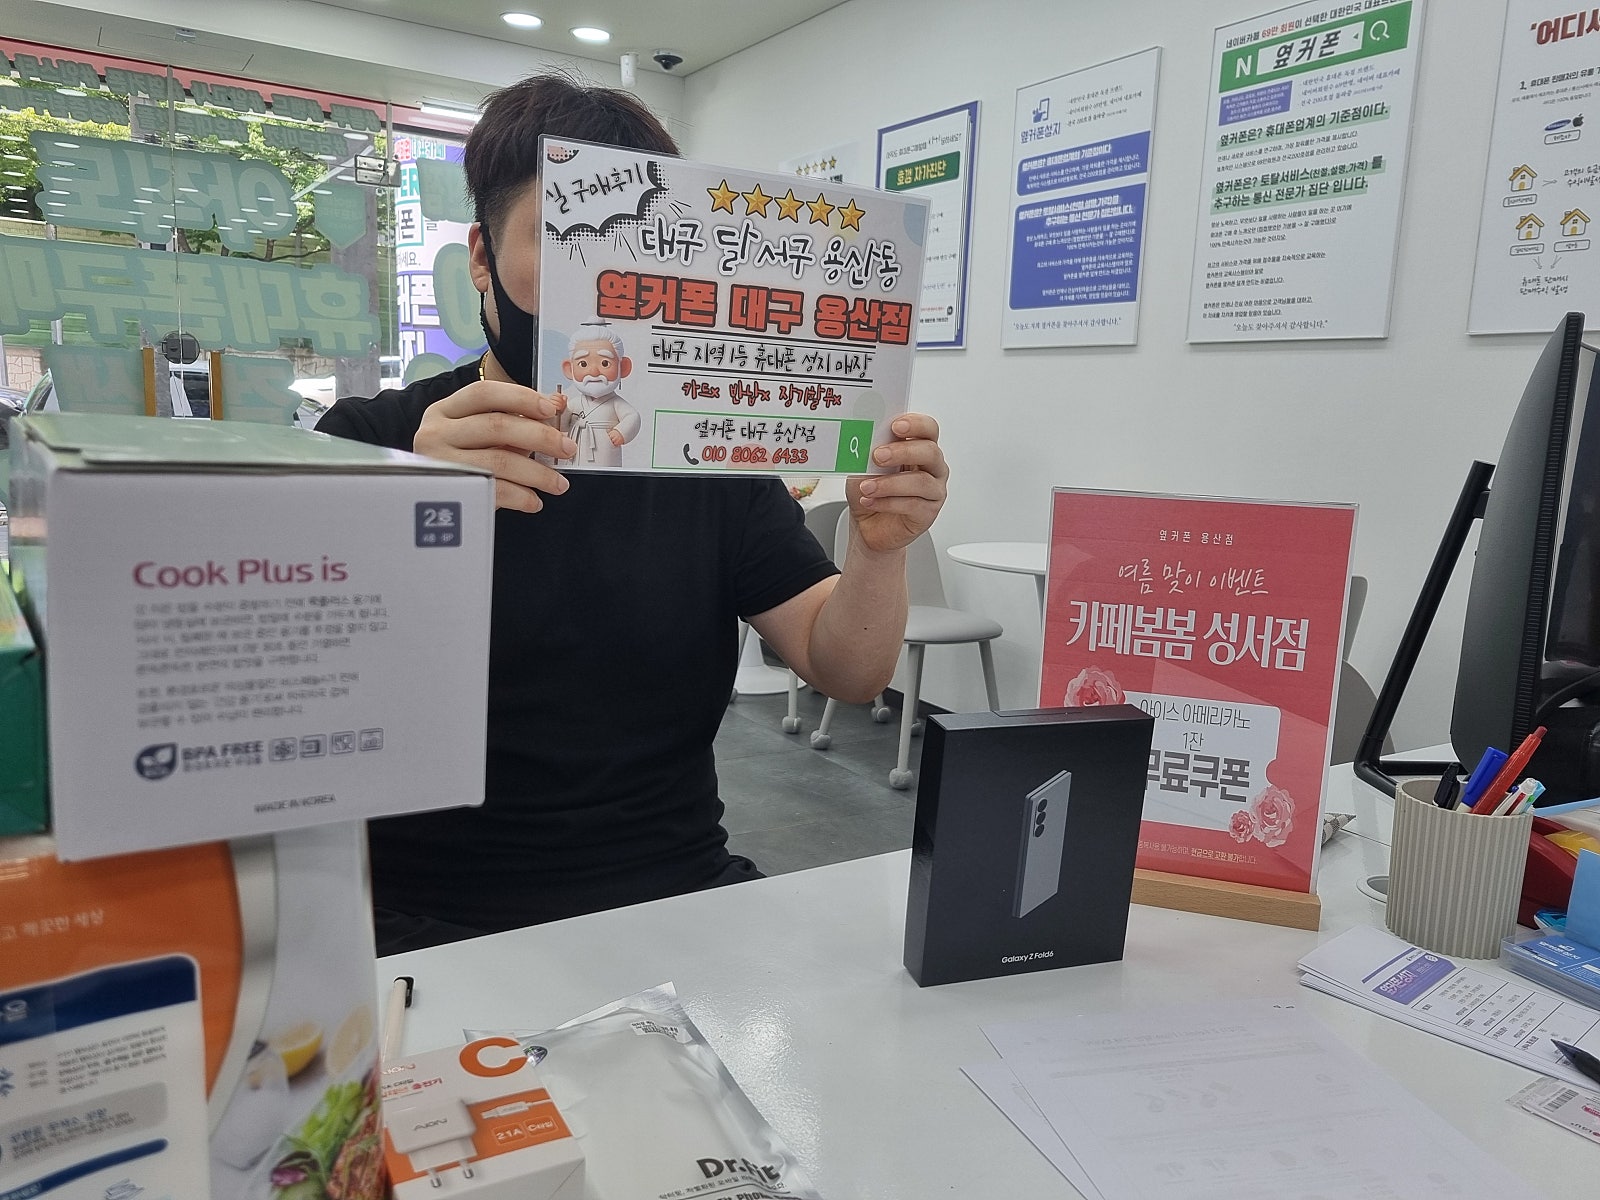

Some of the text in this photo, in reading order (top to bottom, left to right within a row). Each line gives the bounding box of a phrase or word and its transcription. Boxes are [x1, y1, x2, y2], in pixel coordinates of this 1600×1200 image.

[1261, 25, 1277, 38] 69만
[1280, 18, 1302, 33] 회원이
[1304, 11, 1327, 26] 선택한
[1329, 1, 1361, 19] 대한민국
[1235, 54, 1252, 78] N
[1219, 100, 1389, 147] 옆커폰은? 휴대폰업계의 기준점이다.
[914, 158, 947, 182] 자가진단
[1215, 175, 1257, 194] 옆커폰은?
[546, 164, 643, 214] 실 구매후기
[1214, 175, 1369, 209] 추구하는 통신 전문가 집단 입니다.
[641, 217, 703, 260] 대구
[825, 240, 901, 288] 용산동
[598, 270, 912, 345] 옆커폰 대구 용산점
[652, 340, 688, 363] 대구
[756, 346, 796, 372] 휴대폰
[801, 351, 831, 374] 성지
[834, 356, 873, 379] 매장
[694, 420, 817, 443] 옆커폰 대구 용산점
[702, 446, 809, 464] 010 8062 6433
[1159, 529, 1234, 546] 옆커폰 용산점
[133, 555, 349, 588] Cook Plus is
[1118, 558, 1269, 596] 여름 맞이 이벤트
[1066, 600, 1310, 672] 카페봄봄 성서점
[1140, 699, 1251, 729] 아이스 아메리카노
[181, 740, 264, 762] BPA FREE
[1182, 732, 1204, 752] 1잔
[302, 794, 337, 807] KOREA
[1001, 953, 1029, 965] Galaxy
[1034, 950, 1054, 960] Fold6
[459, 1037, 528, 1078] C
